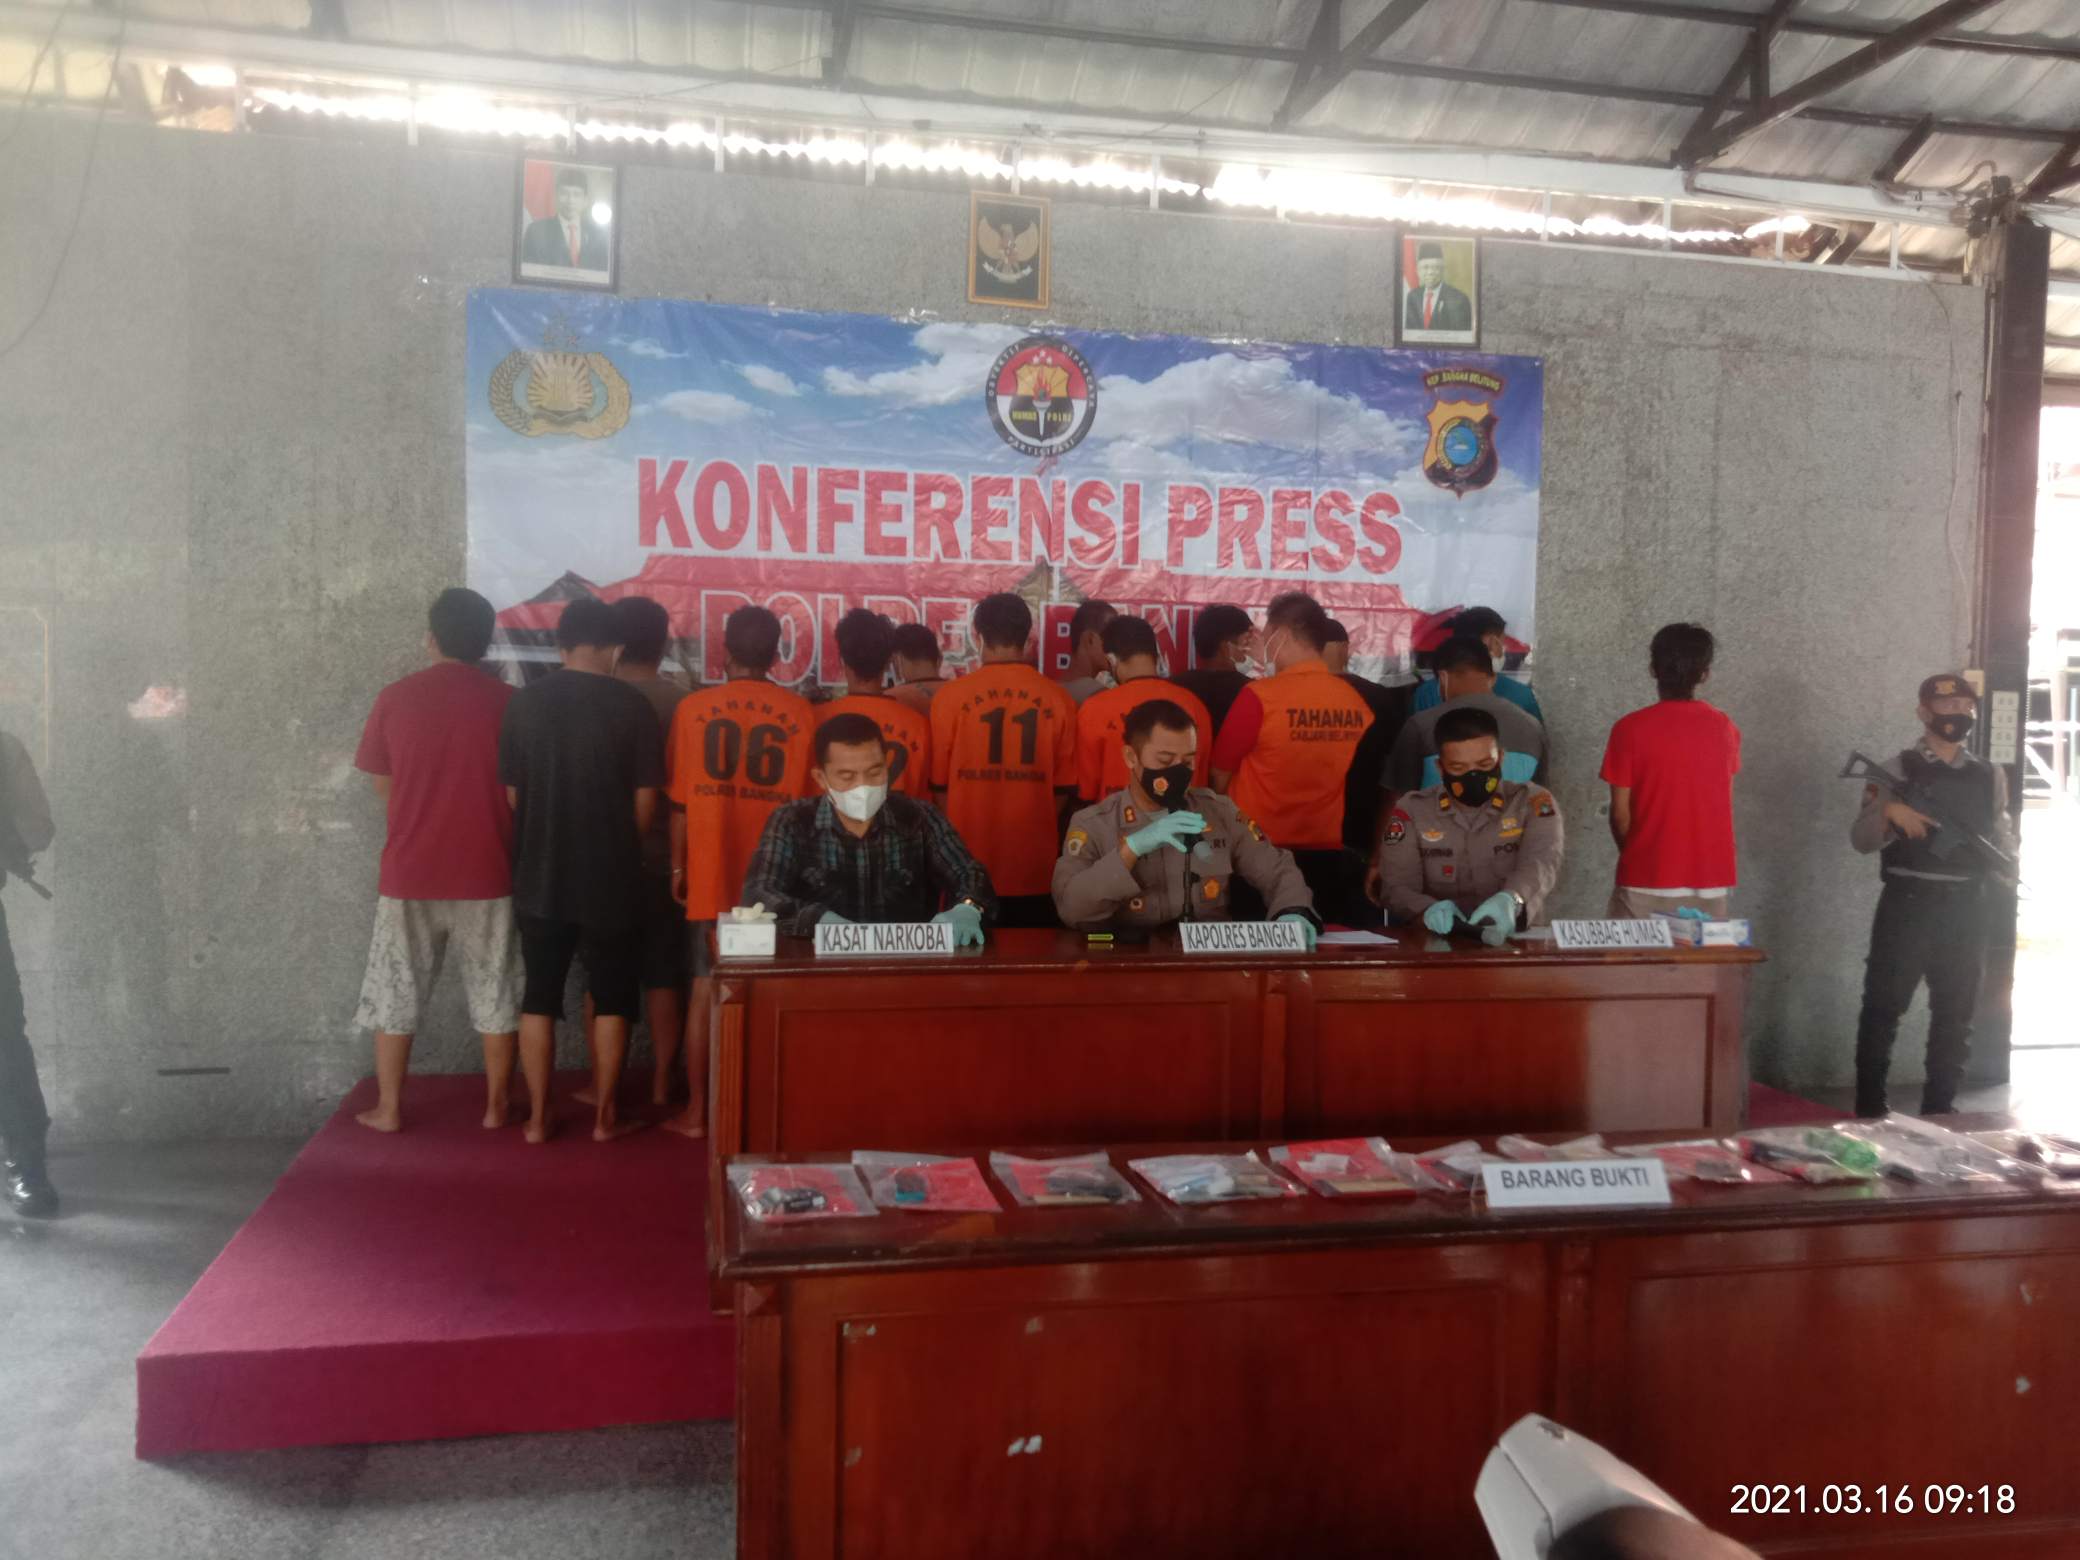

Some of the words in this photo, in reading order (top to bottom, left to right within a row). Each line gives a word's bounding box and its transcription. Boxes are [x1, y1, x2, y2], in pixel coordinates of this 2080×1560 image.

[637, 457, 1141, 568] KONFERENSI
[1166, 484, 1402, 575] PRESS
[1286, 708, 1364, 729] TAHANAN
[979, 707, 1039, 766] 11
[703, 718, 788, 786] 06
[823, 925, 869, 951] KASAT
[873, 924, 946, 951] NARKOBA
[1185, 923, 1247, 950] KAPOLRES
[1248, 923, 1298, 948] BANGKA
[1558, 920, 1622, 945] KASUBBAG
[1622, 920, 1666, 944] HUMAS
[1501, 1169, 1586, 1189] BARANG
[1591, 1167, 1651, 1187] BUKTI
